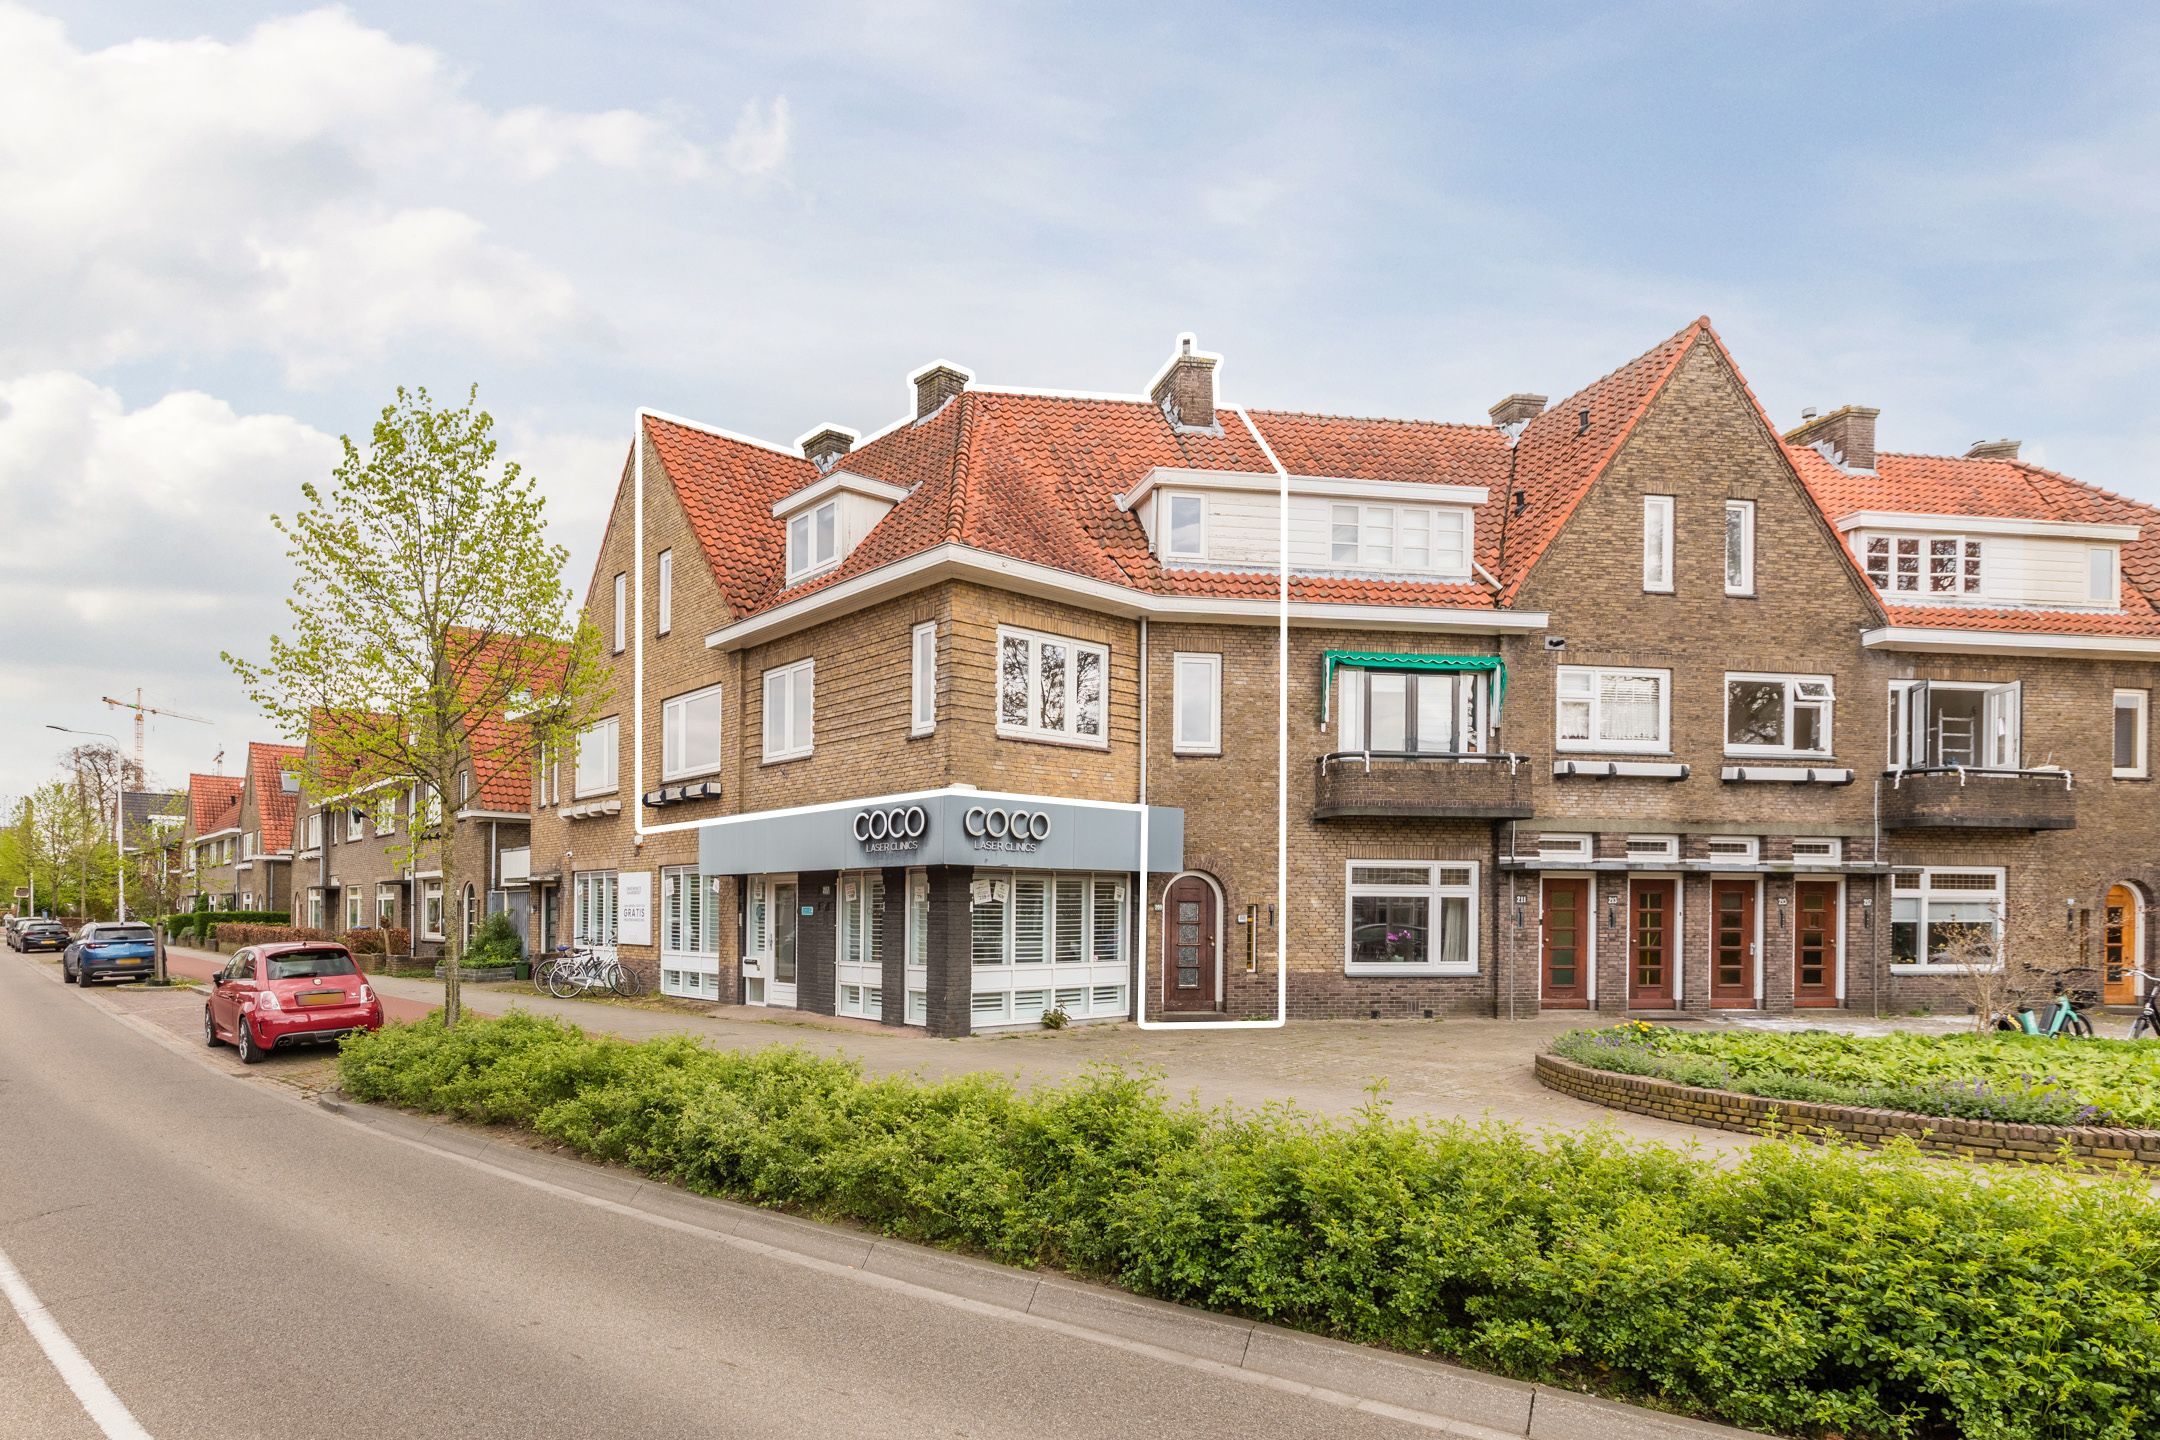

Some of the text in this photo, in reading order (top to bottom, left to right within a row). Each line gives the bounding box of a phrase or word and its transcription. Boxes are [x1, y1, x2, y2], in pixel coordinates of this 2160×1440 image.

[853, 806, 925, 841] COCO
[966, 806, 1052, 840] COCO
[865, 841, 918, 853] LASER CLINICS
[974, 840, 1037, 853] LASER CLINICS
[624, 908, 645, 918] GRATIS
